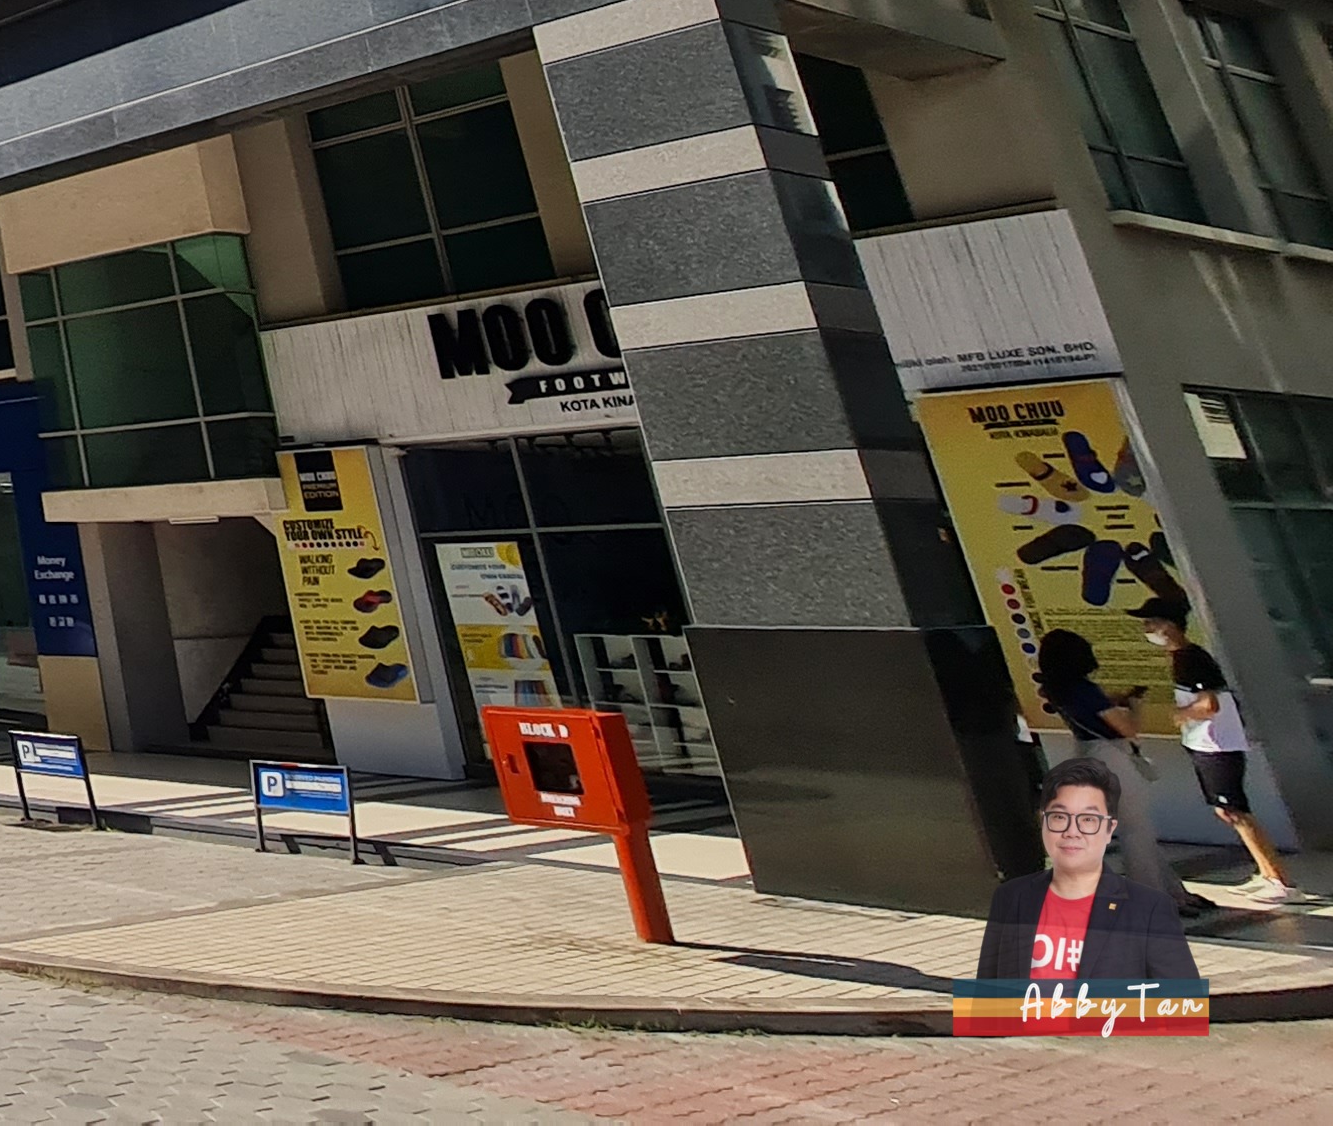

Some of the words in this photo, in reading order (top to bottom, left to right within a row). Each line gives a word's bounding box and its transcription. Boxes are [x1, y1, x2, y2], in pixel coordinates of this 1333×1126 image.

[427, 298, 576, 379] MOO
[988, 348, 1024, 360] LUXE
[560, 398, 600, 413] KOTA
[967, 405, 1010, 423] MOO
[1013, 400, 1065, 420] CHUU
[283, 518, 334, 532] CUSTOMIZE
[285, 530, 311, 541] YOUR
[312, 529, 334, 541] OWN
[334, 527, 364, 540] STYLE
[37, 555, 66, 567] Money
[299, 554, 333, 564] WALKING
[34, 569, 75, 582] Exchange
[300, 565, 335, 575] WITHOUT
[302, 576, 320, 586] PAIN
[267, 775, 278, 793] P
